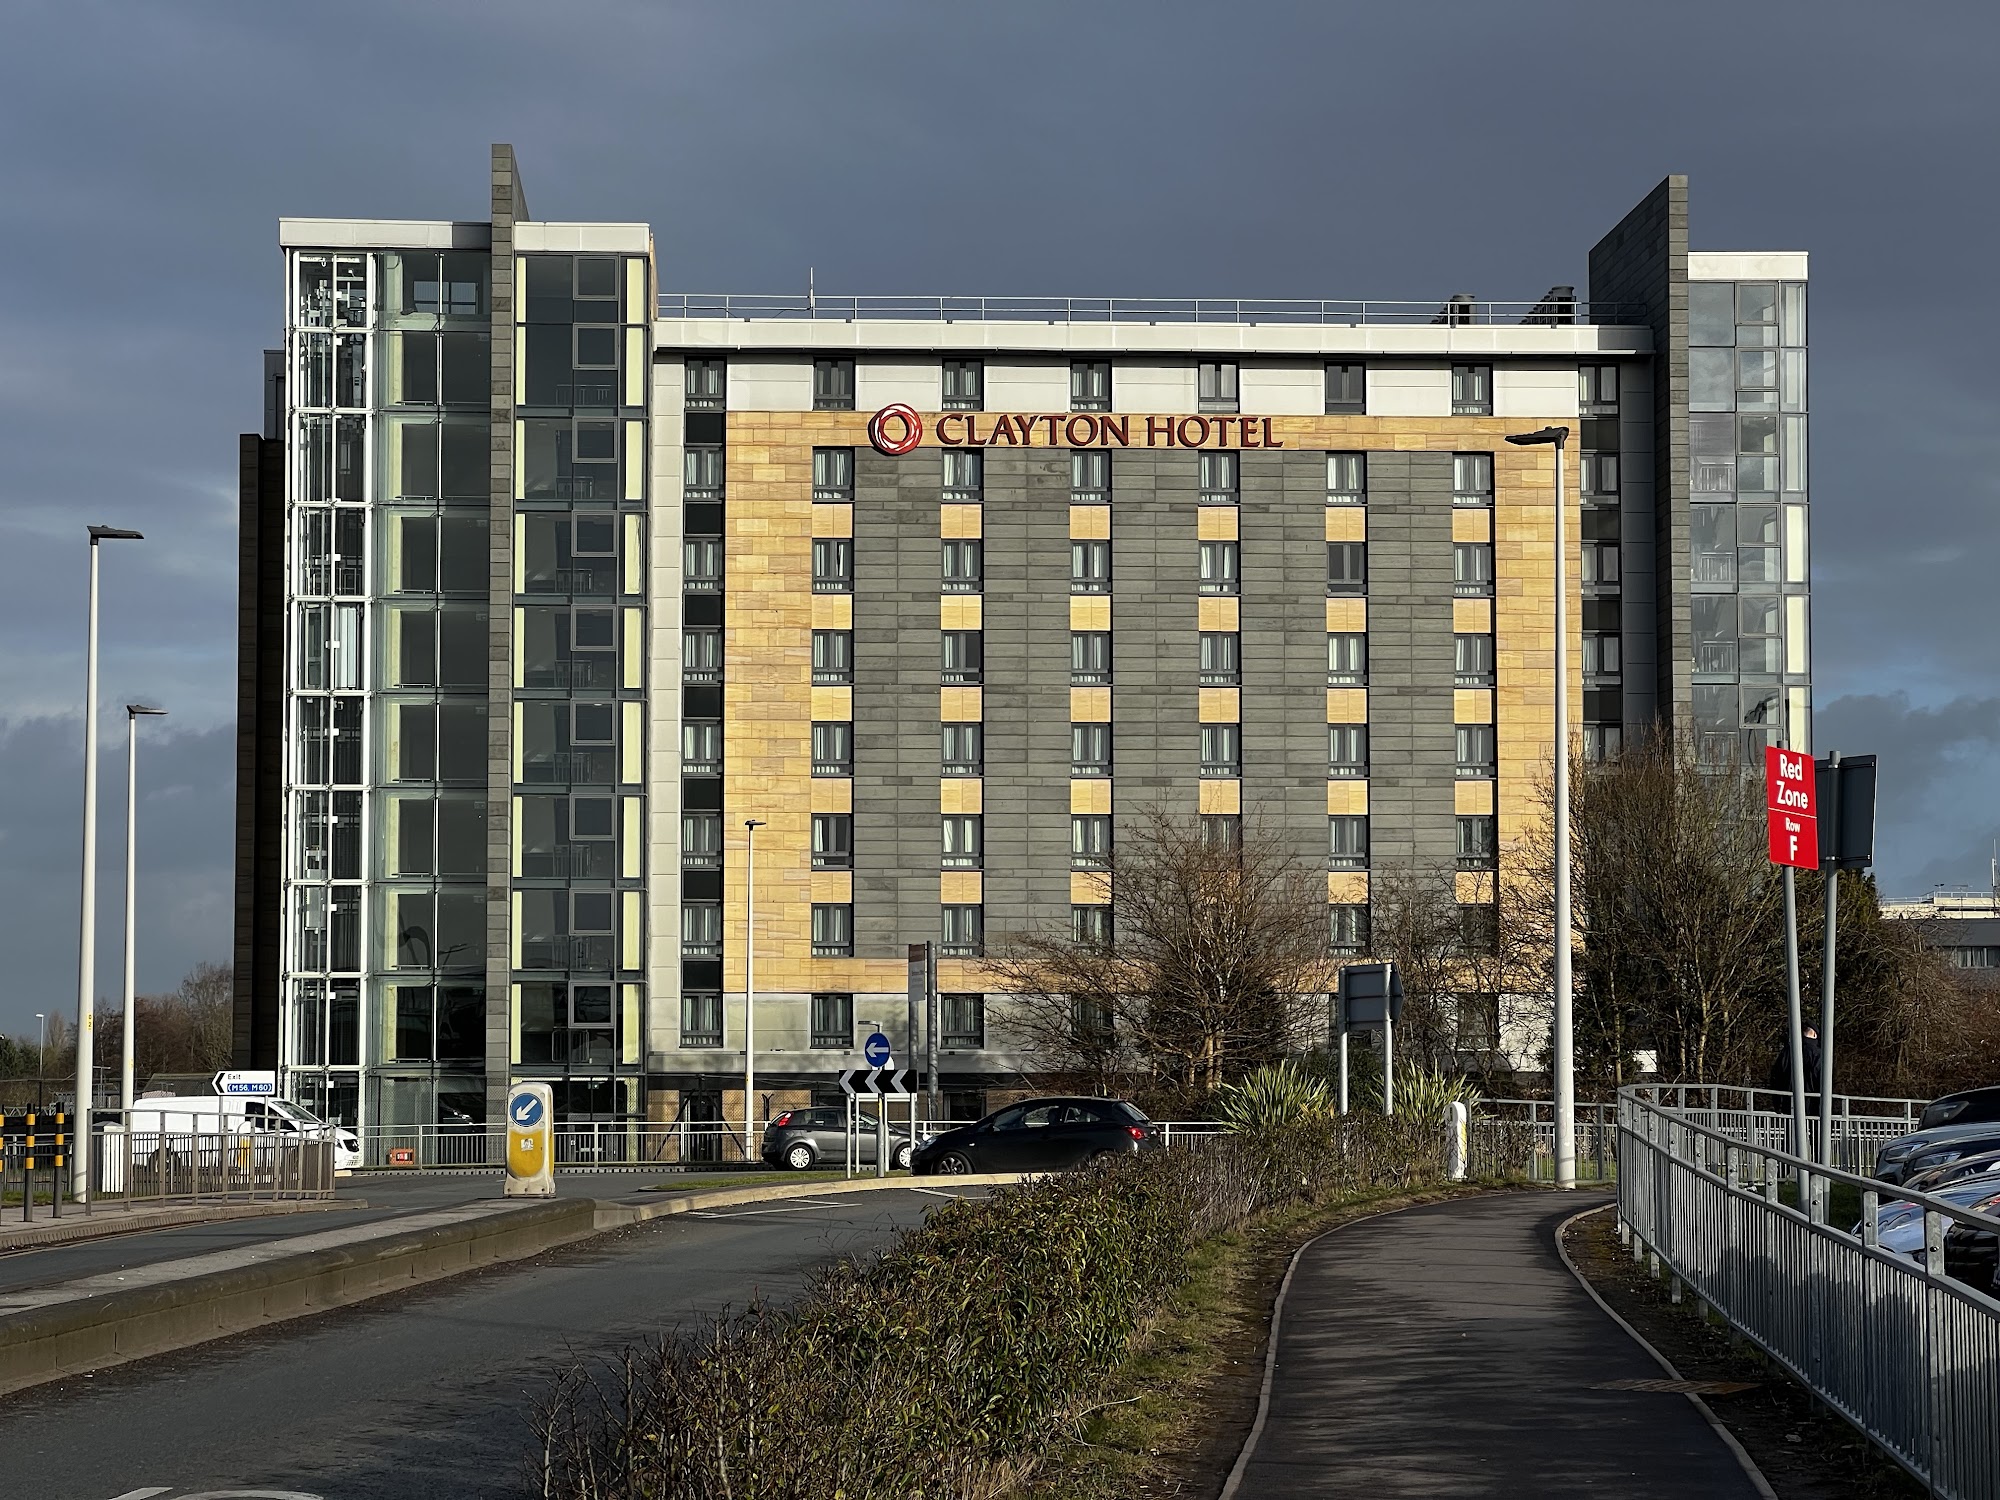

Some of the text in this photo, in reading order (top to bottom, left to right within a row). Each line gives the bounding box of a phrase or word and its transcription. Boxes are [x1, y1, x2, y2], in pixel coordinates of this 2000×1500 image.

[936, 413, 1284, 448] CLAYTON HOTEL
[1779, 753, 1802, 780] Red
[1776, 780, 1808, 809] Zone
[1785, 817, 1800, 832] Row
[1789, 835, 1798, 861] F
